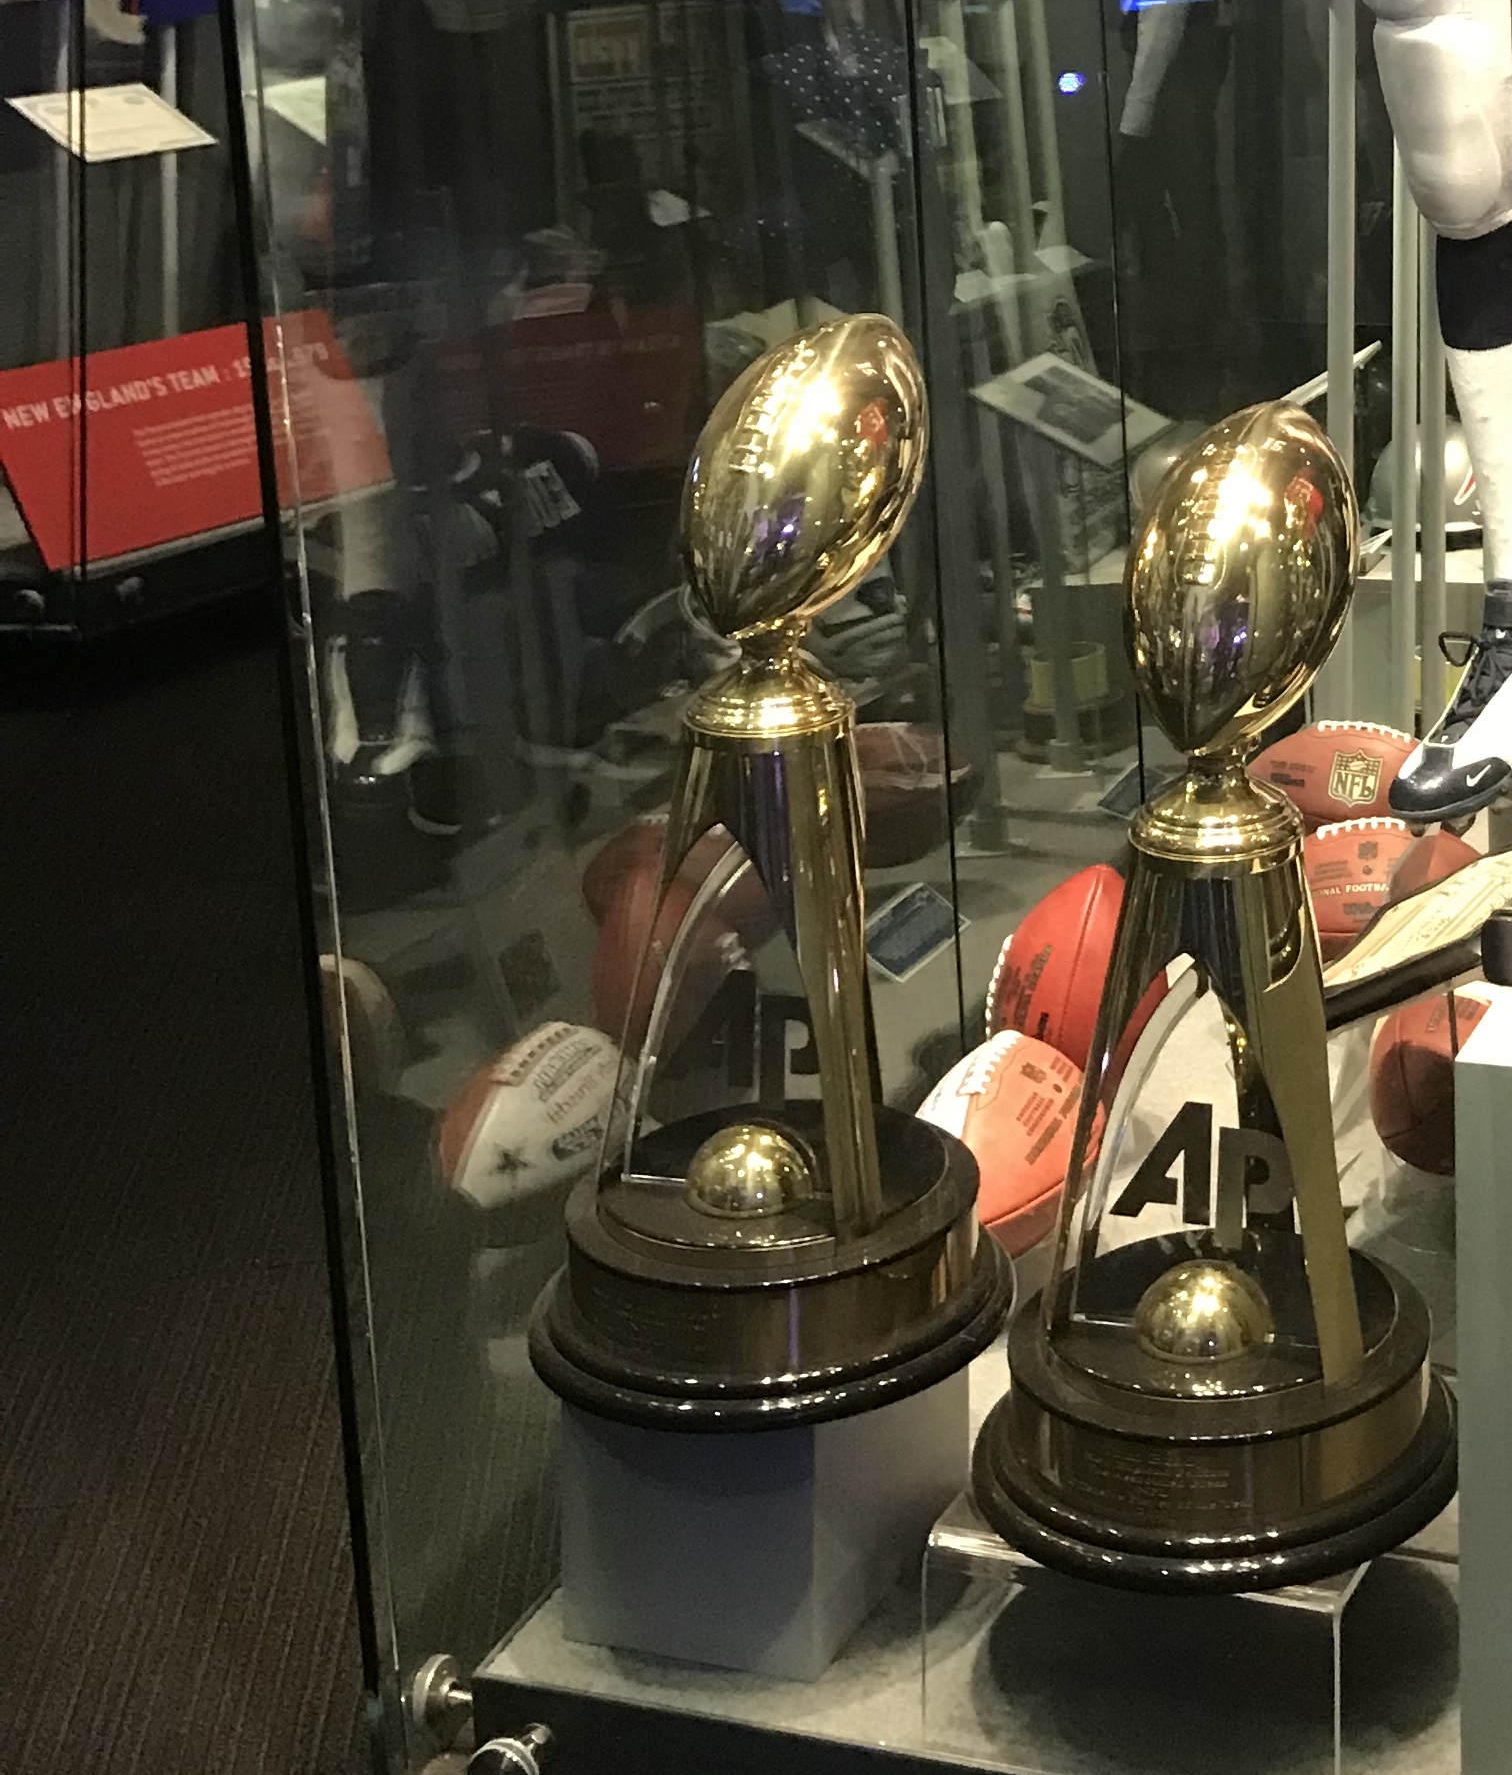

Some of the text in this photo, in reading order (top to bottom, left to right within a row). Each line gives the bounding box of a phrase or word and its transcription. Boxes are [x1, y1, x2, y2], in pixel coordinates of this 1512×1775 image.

[2, 400, 50, 431] NEW
[52, 376, 168, 420] ENGLAND'S
[165, 364, 222, 393] TEAM
[1333, 772, 1375, 798] NFL
[1345, 882, 1391, 894] FOOTBA
[1110, 1100, 1302, 1249] AP
